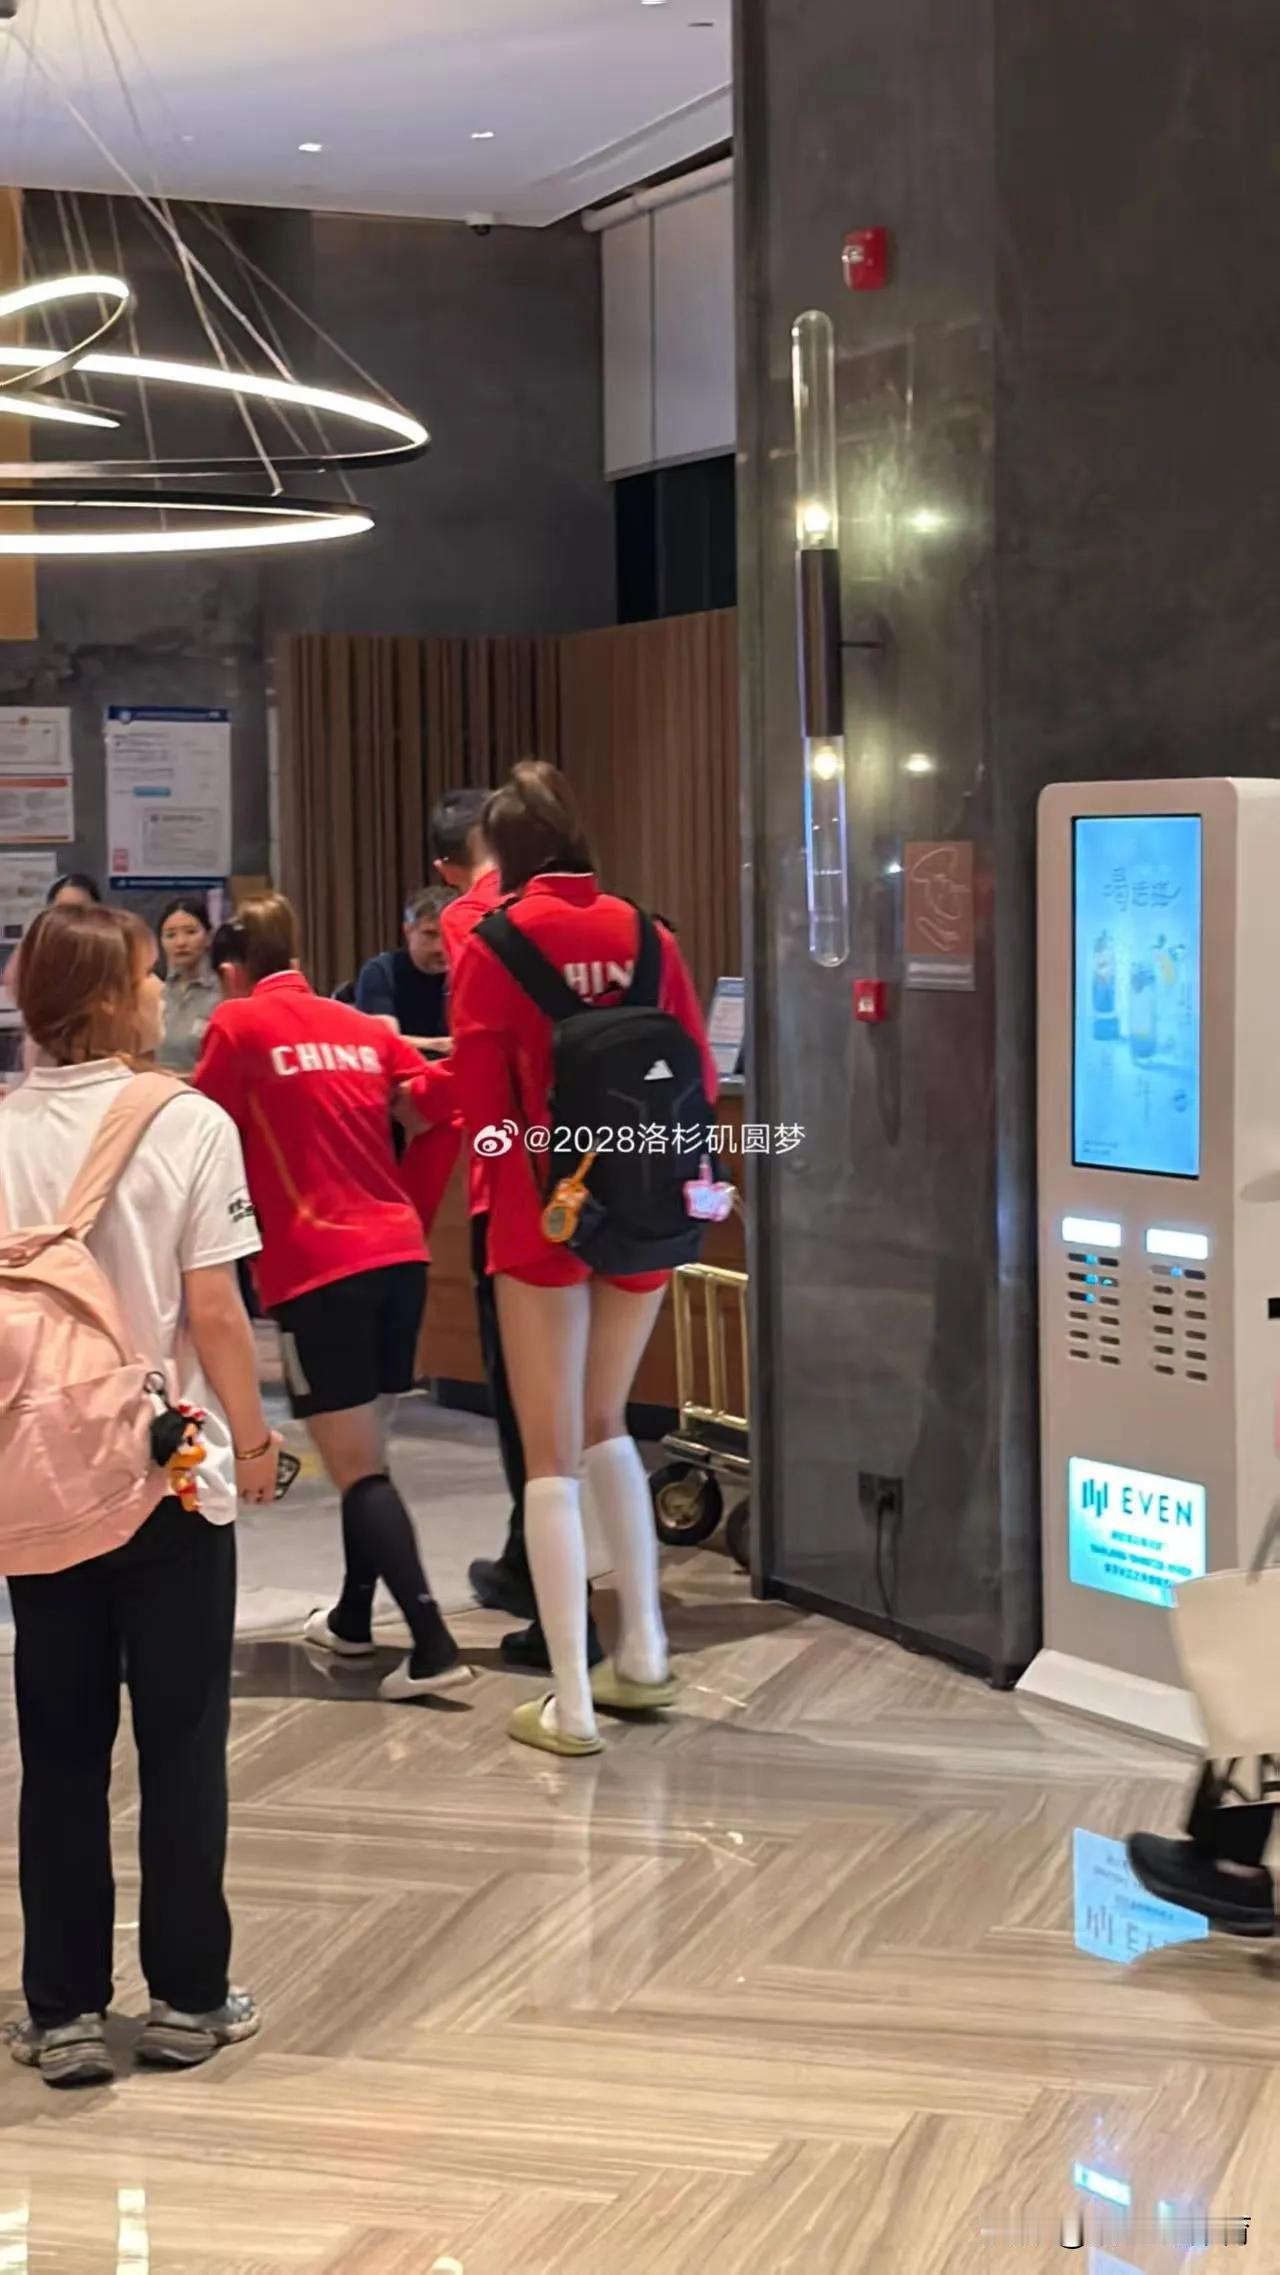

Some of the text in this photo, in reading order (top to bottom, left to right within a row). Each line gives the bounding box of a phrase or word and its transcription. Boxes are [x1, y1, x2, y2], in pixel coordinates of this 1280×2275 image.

[563, 960, 635, 996] HIN
[270, 1042, 382, 1076] CHINA
[1121, 1486, 1193, 1527] EVEN
